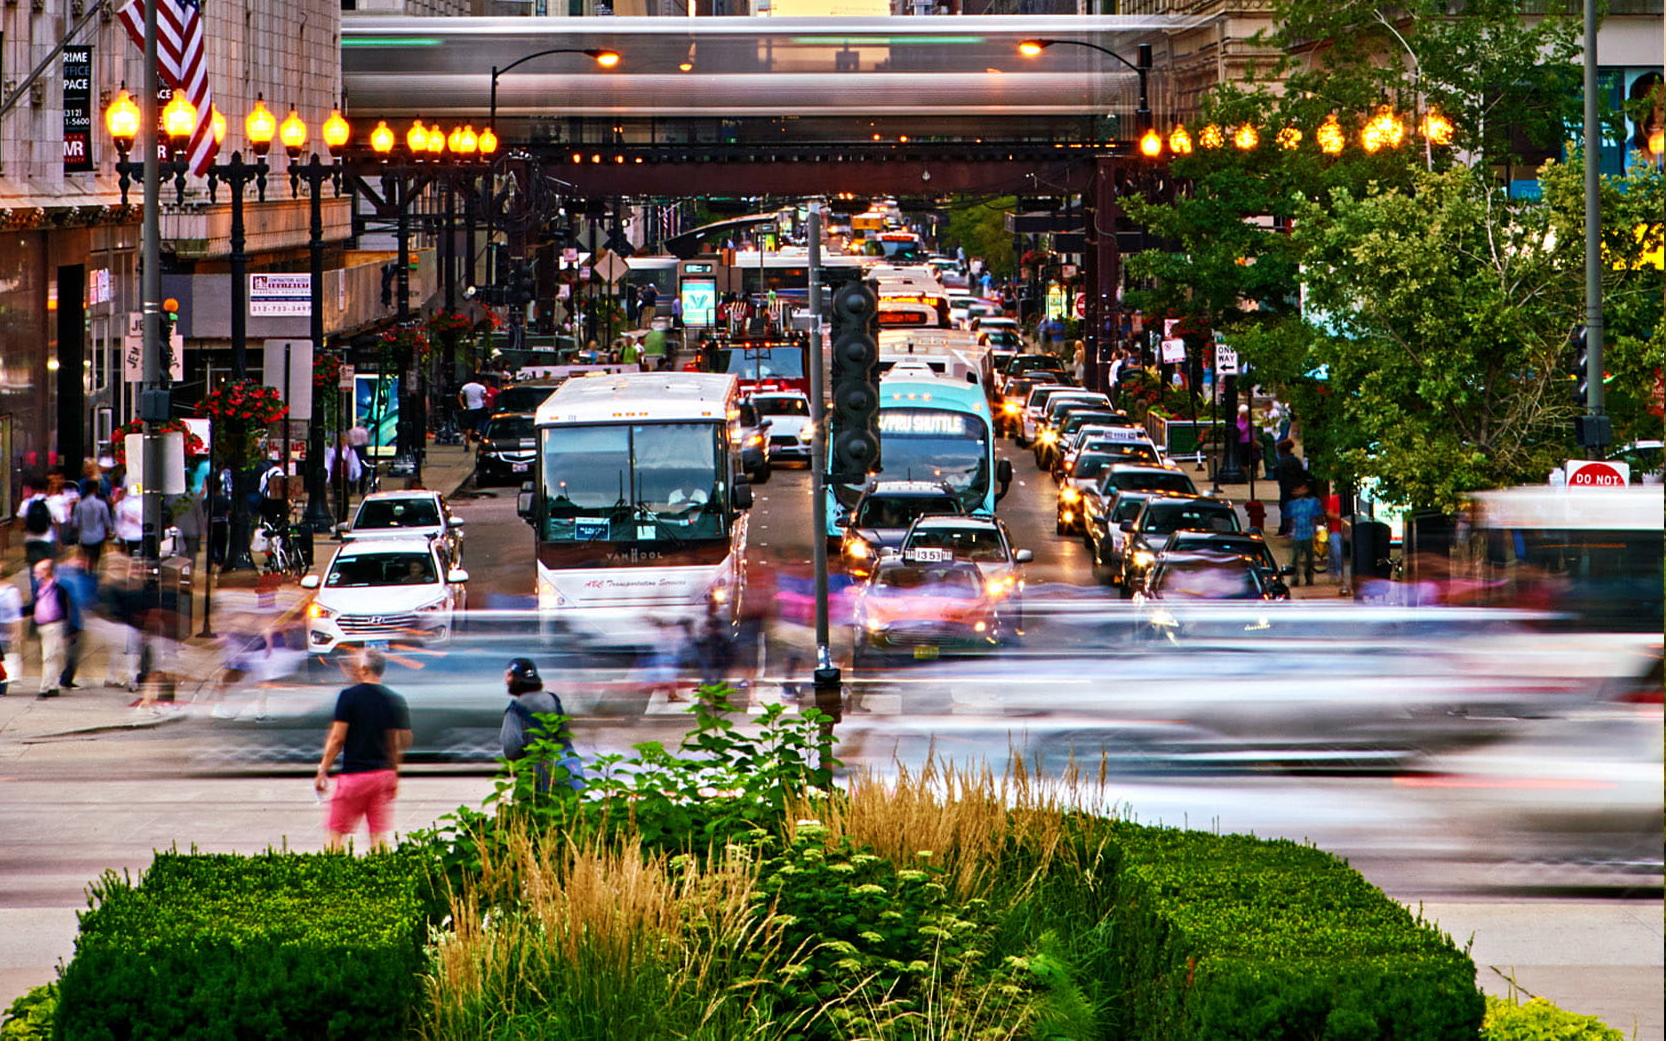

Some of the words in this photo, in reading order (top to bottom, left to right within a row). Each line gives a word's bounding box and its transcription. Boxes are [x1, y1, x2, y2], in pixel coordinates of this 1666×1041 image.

[912, 414, 963, 432] SHUTTLE
[1576, 473, 1592, 484] DO
[1596, 474, 1619, 486] NOT
